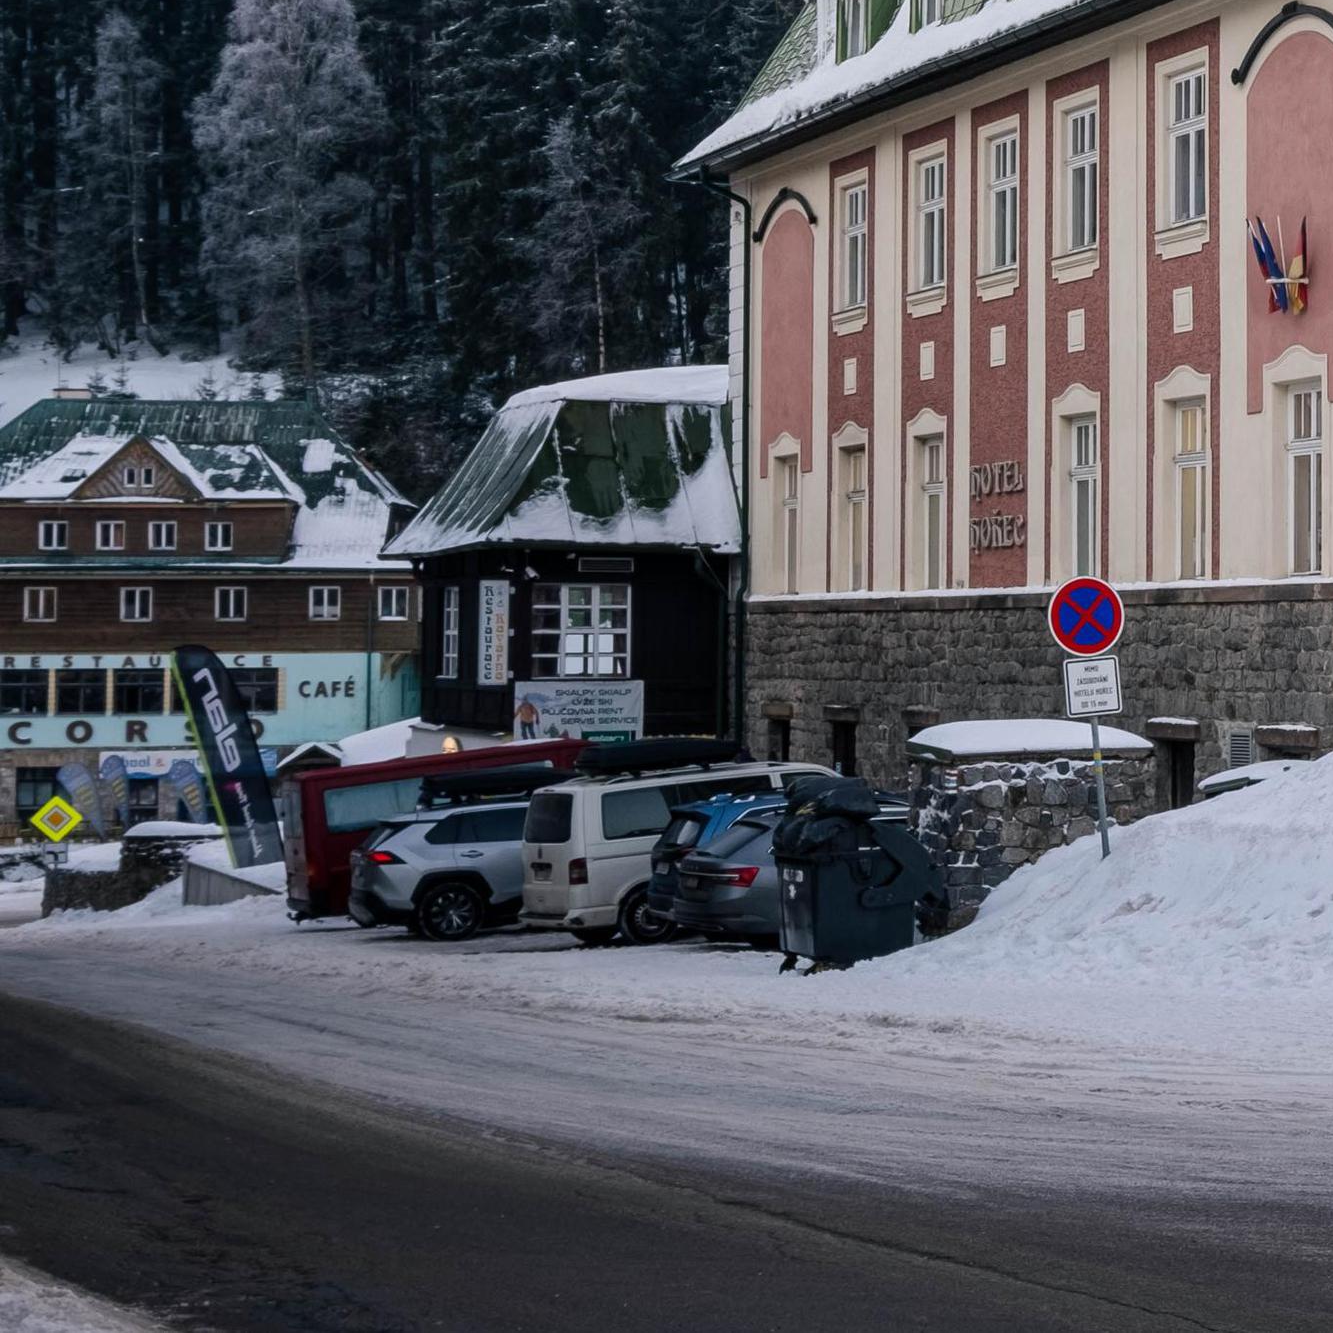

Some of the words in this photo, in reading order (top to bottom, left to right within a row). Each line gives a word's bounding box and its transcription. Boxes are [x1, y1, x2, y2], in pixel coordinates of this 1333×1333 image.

[970, 461, 1024, 502] HOTEL
[4, 655, 273, 667] RESTAUCE
[298, 676, 356, 698] CAFÉ
